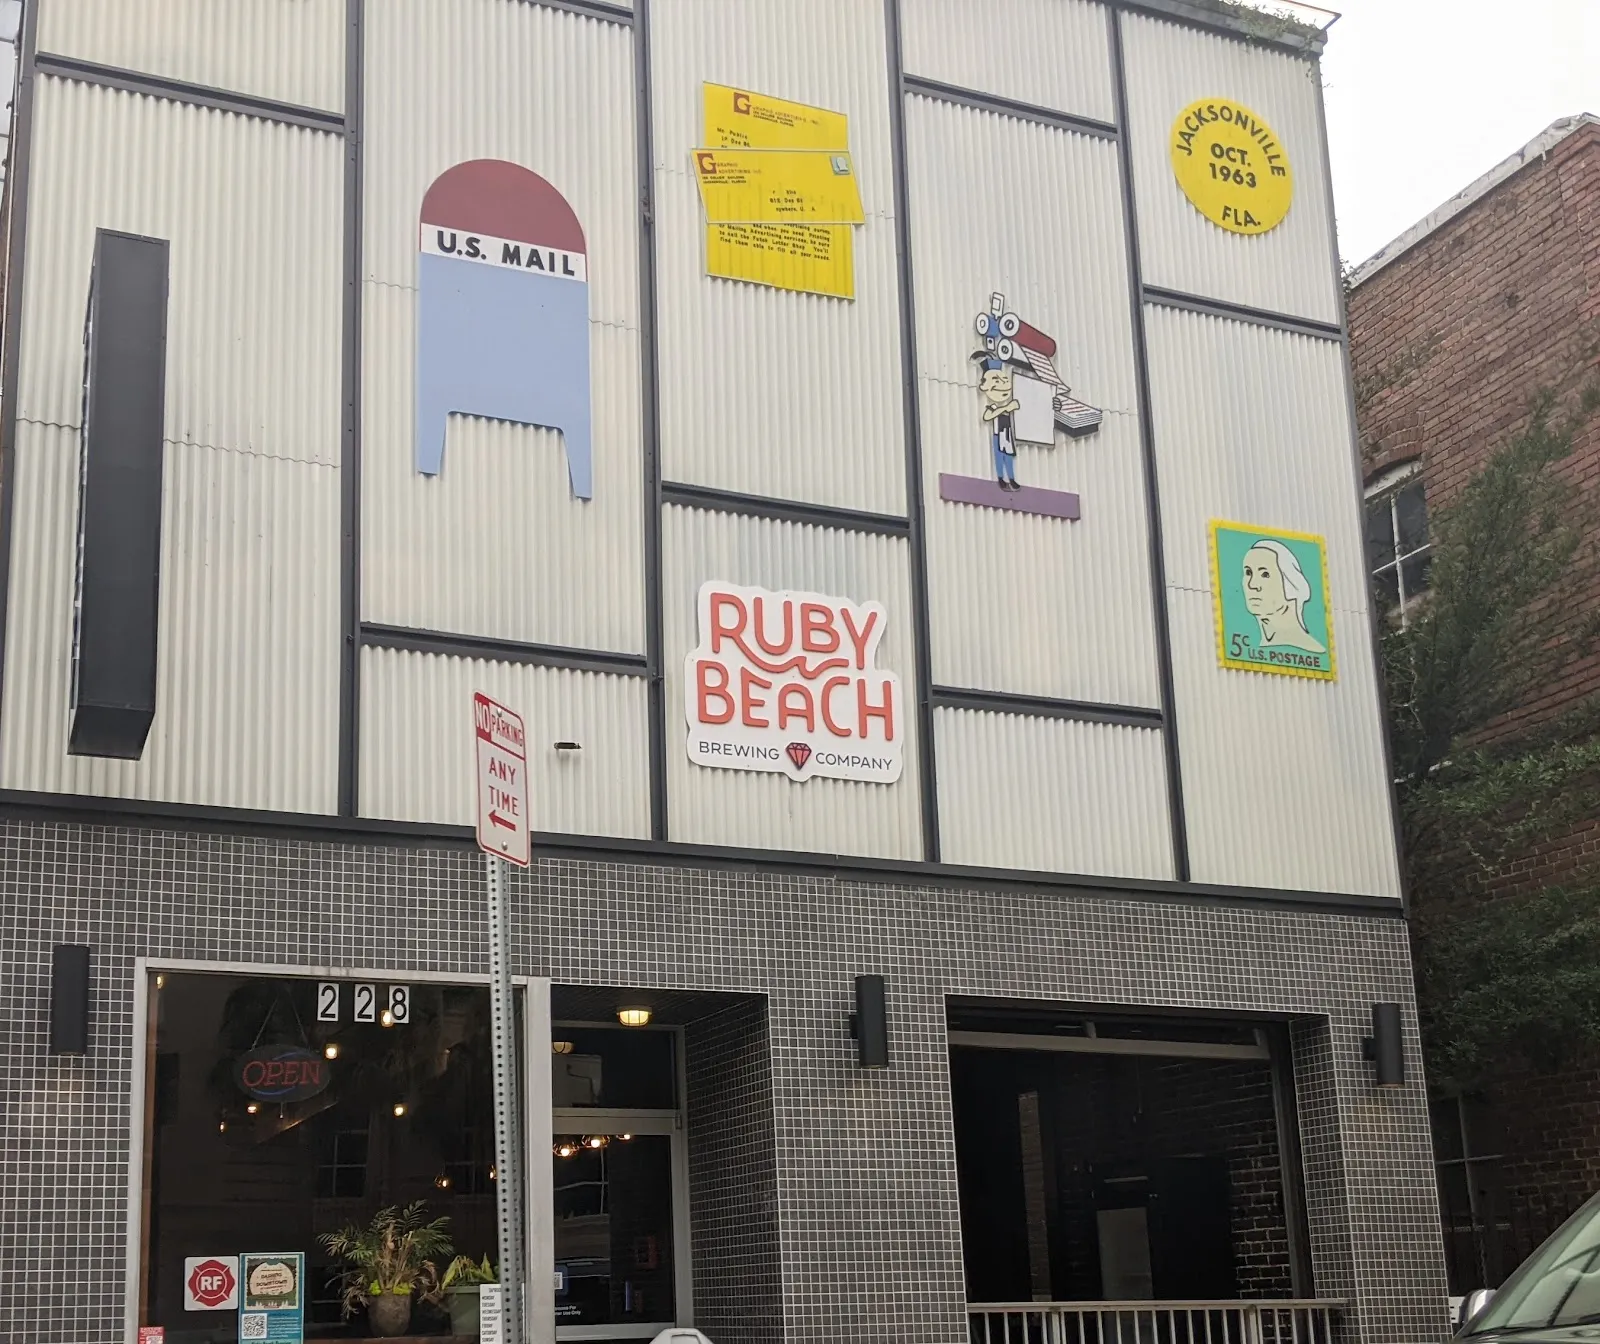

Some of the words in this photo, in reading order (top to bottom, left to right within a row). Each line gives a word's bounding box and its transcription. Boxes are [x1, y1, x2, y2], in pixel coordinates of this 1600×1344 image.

[1176, 104, 1286, 176] JACKSONVILLE
[1210, 143, 1251, 166] OCT.
[1209, 162, 1256, 188] 1963
[1222, 206, 1261, 227] FLA.
[437, 230, 486, 260] U.S.
[501, 243, 575, 276] MAIL
[710, 592, 877, 679] RUBY
[1248, 648, 1267, 661] U.S.
[1270, 651, 1321, 667] POSTAGE
[697, 660, 893, 741] BEACH
[475, 700, 490, 733] NO
[491, 714, 523, 747] PARKING
[699, 741, 780, 760] BREWING
[815, 752, 892, 770] COMPANY
[489, 757, 516, 785] ANY
[488, 785, 519, 816] TIME
[242, 1060, 321, 1087] OPEN
[200, 1275, 223, 1291] RF
